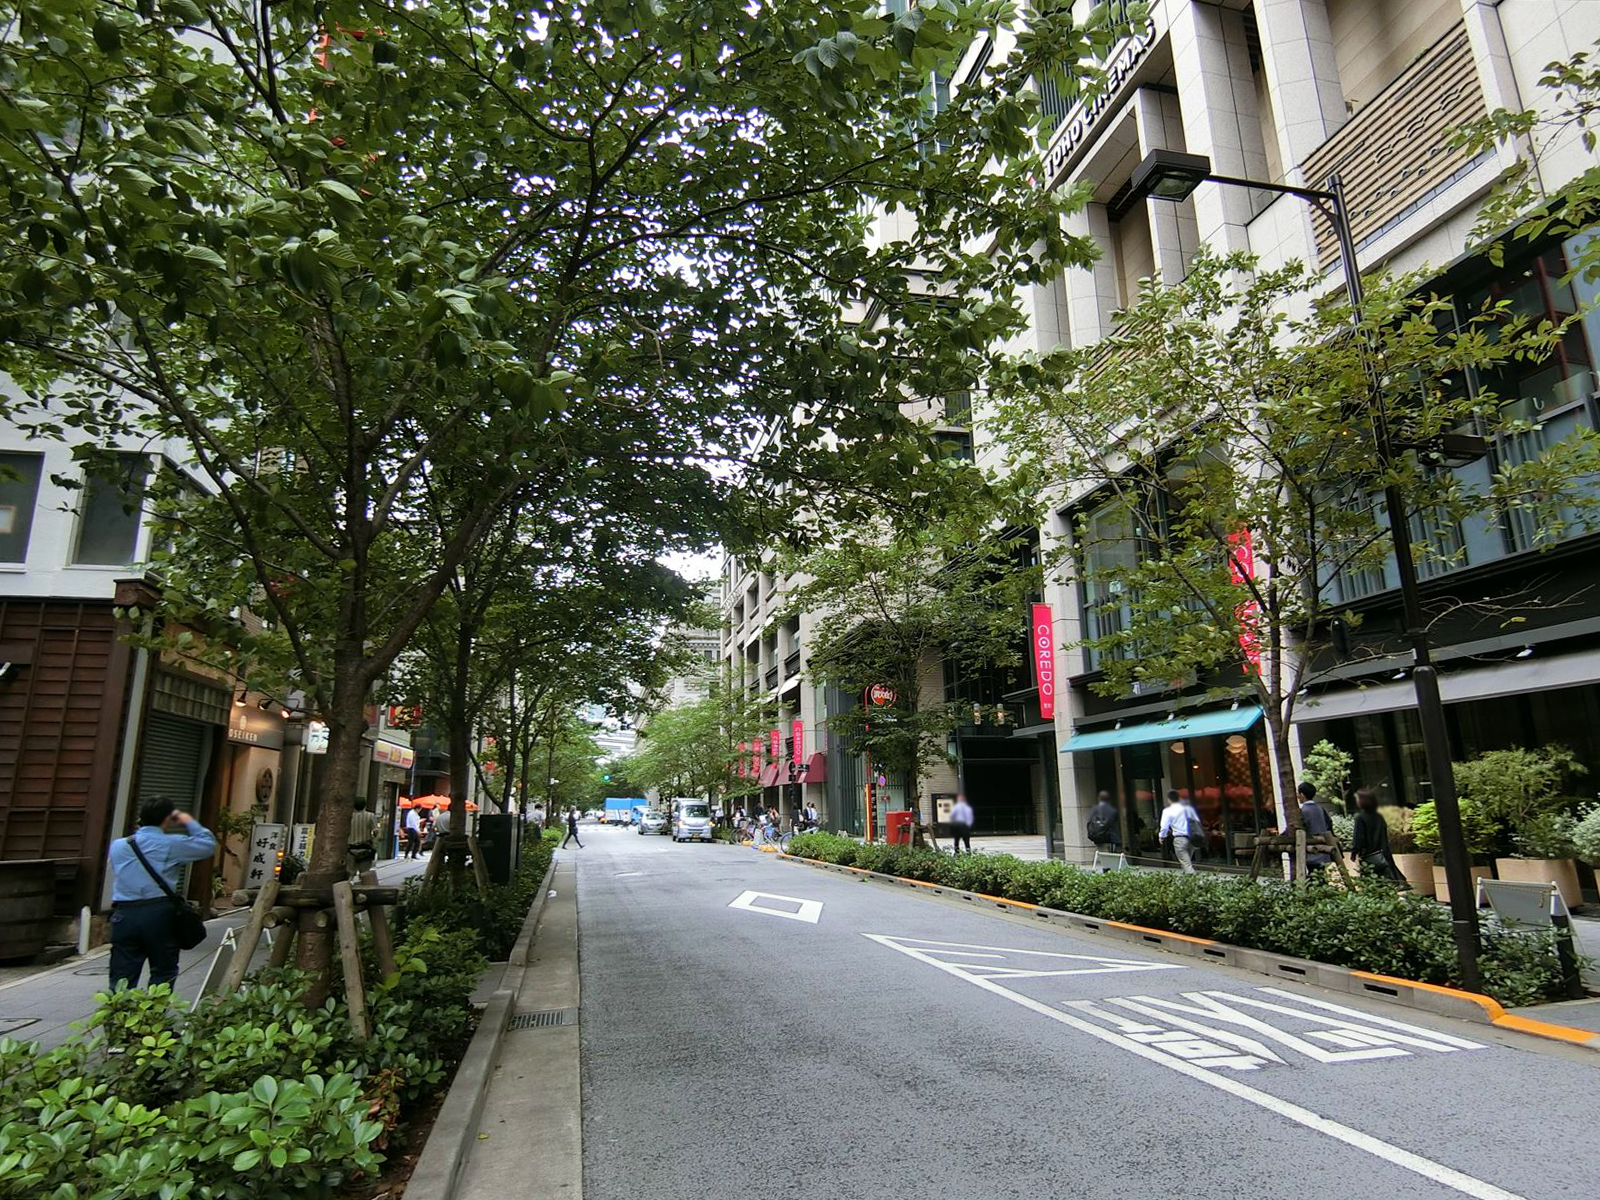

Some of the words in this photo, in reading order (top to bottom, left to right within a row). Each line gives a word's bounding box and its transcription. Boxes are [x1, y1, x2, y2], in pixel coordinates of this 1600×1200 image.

[1044, 120, 1083, 178] TOHO
[1037, 624, 1053, 697] COREDO
[249, 837, 270, 880] 好成軒
[268, 831, 279, 851] 洋食
